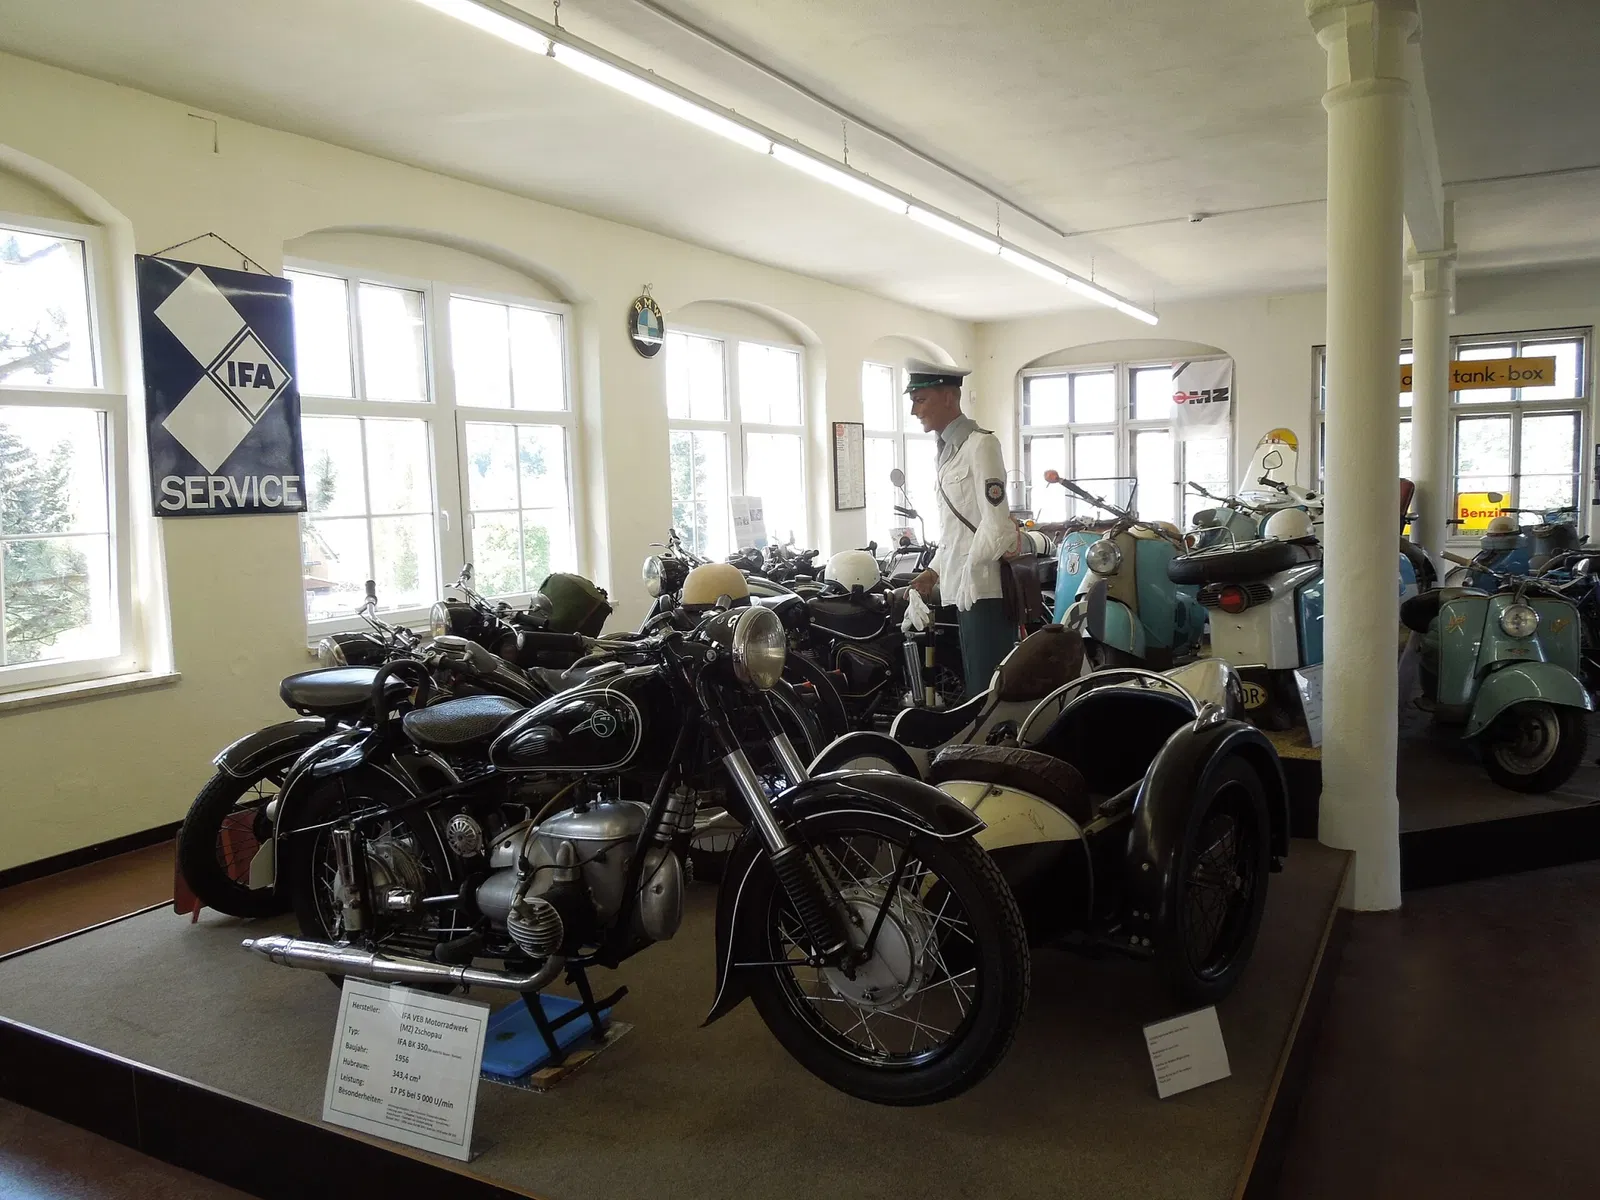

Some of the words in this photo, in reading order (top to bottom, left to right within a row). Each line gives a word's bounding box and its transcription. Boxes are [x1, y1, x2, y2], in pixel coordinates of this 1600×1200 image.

[635, 298, 661, 317] BMW
[227, 361, 276, 390] IFA
[1453, 366, 1495, 383] tank
[1508, 365, 1543, 381] box
[1189, 387, 1229, 405] MZ
[160, 475, 302, 511] SERVICE
[1461, 508, 1508, 518] Benzin
[351, 1001, 381, 1014] Hersteller:
[401, 1012, 411, 1021] IFA
[412, 1014, 424, 1023] VEB
[425, 1017, 469, 1033] Motorradwerk
[348, 1026, 360, 1036] Typ:
[397, 1038, 407, 1047] IFA
[407, 1040, 417, 1048] BK
[417, 1042, 429, 1052] 350
[399, 1023, 414, 1035] (MZ)
[414, 1026, 443, 1040] Zschopau
[345, 1041, 369, 1054] Baujahr:
[395, 1054, 410, 1064] 1956
[342, 1057, 370, 1070] Hubraum:
[392, 1069, 408, 1081] 343,4
[338, 1086, 384, 1104] Besonderheiten:
[340, 1073, 365, 1087] Leistung:
[390, 1086, 397, 1094] 17
[398, 1088, 406, 1096] PS
[406, 1090, 417, 1099] bei
[421, 1095, 433, 1104] 000
[434, 1097, 454, 1109] U/min
